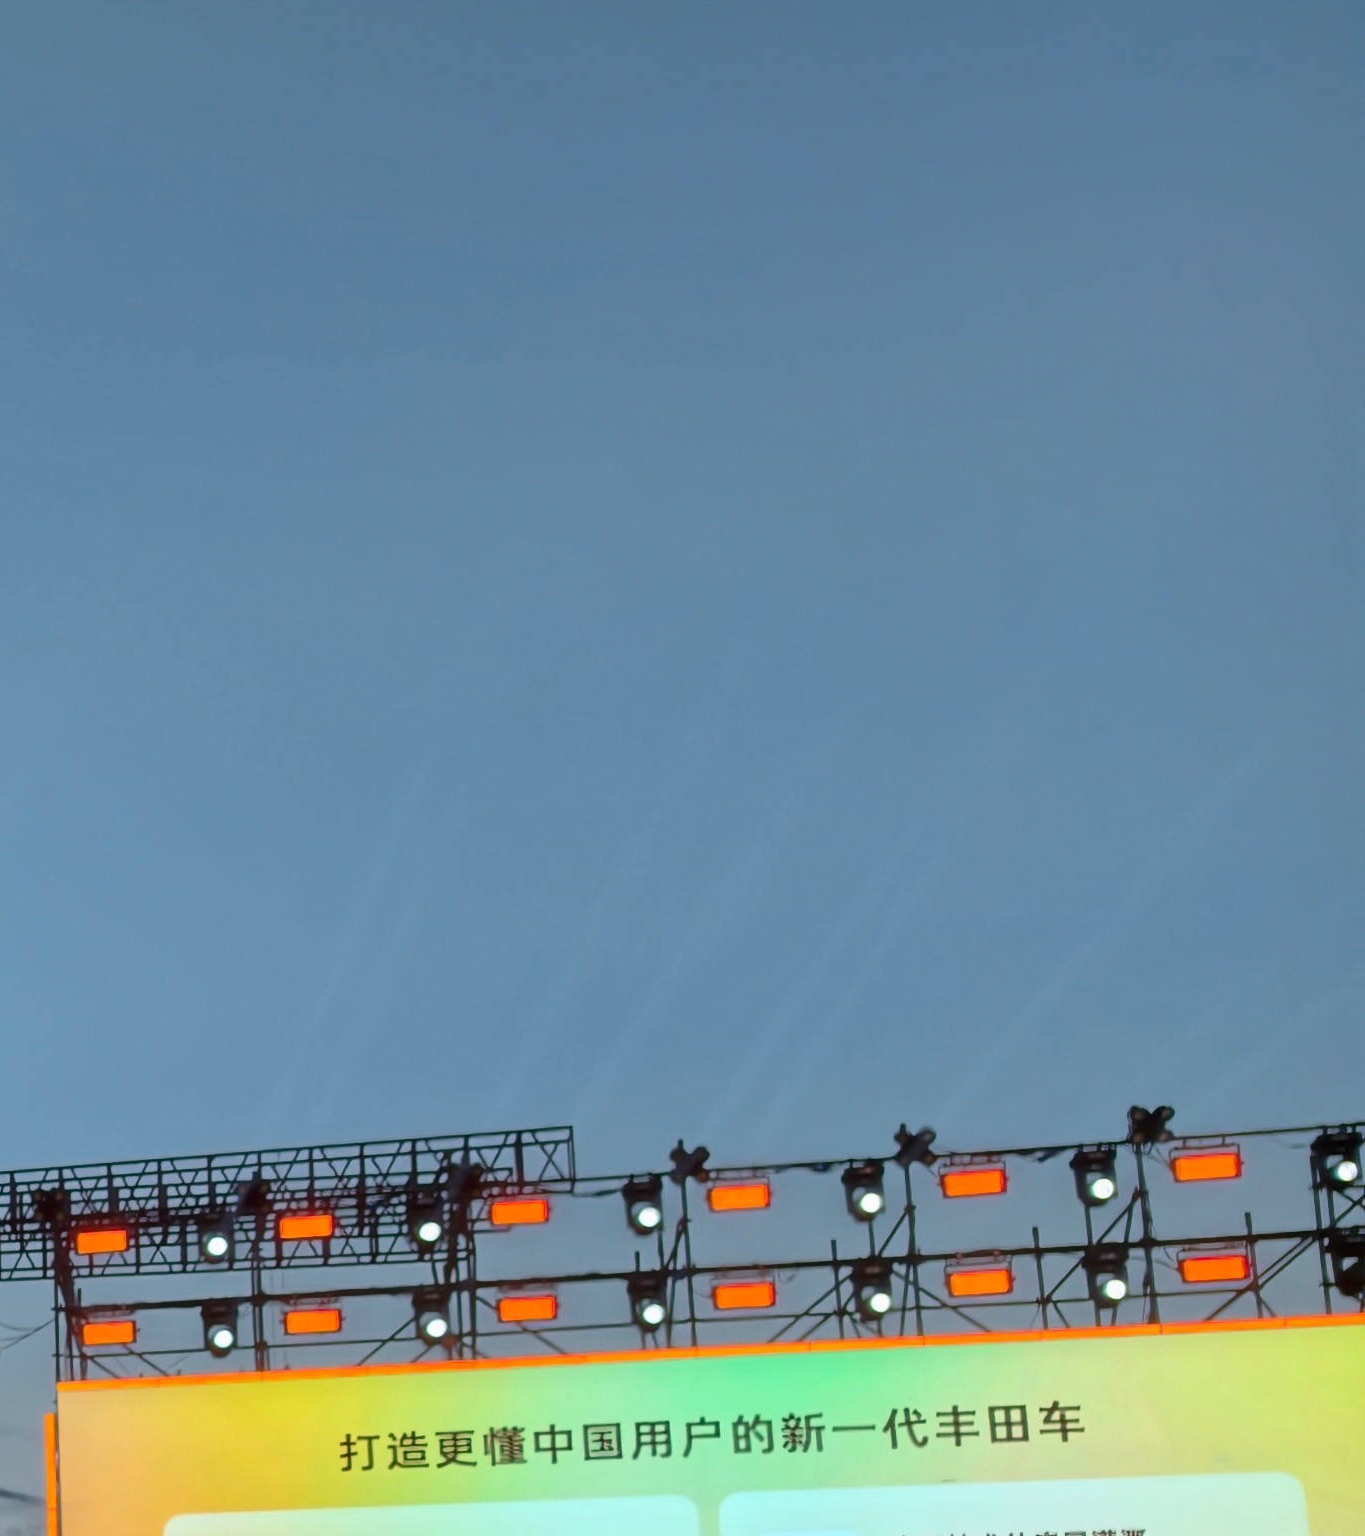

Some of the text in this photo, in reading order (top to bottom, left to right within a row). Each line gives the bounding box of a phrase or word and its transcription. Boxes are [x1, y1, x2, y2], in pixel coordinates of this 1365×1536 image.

[339, 1400, 1086, 1472] 打造更懂中国用户的新一代丰田车
